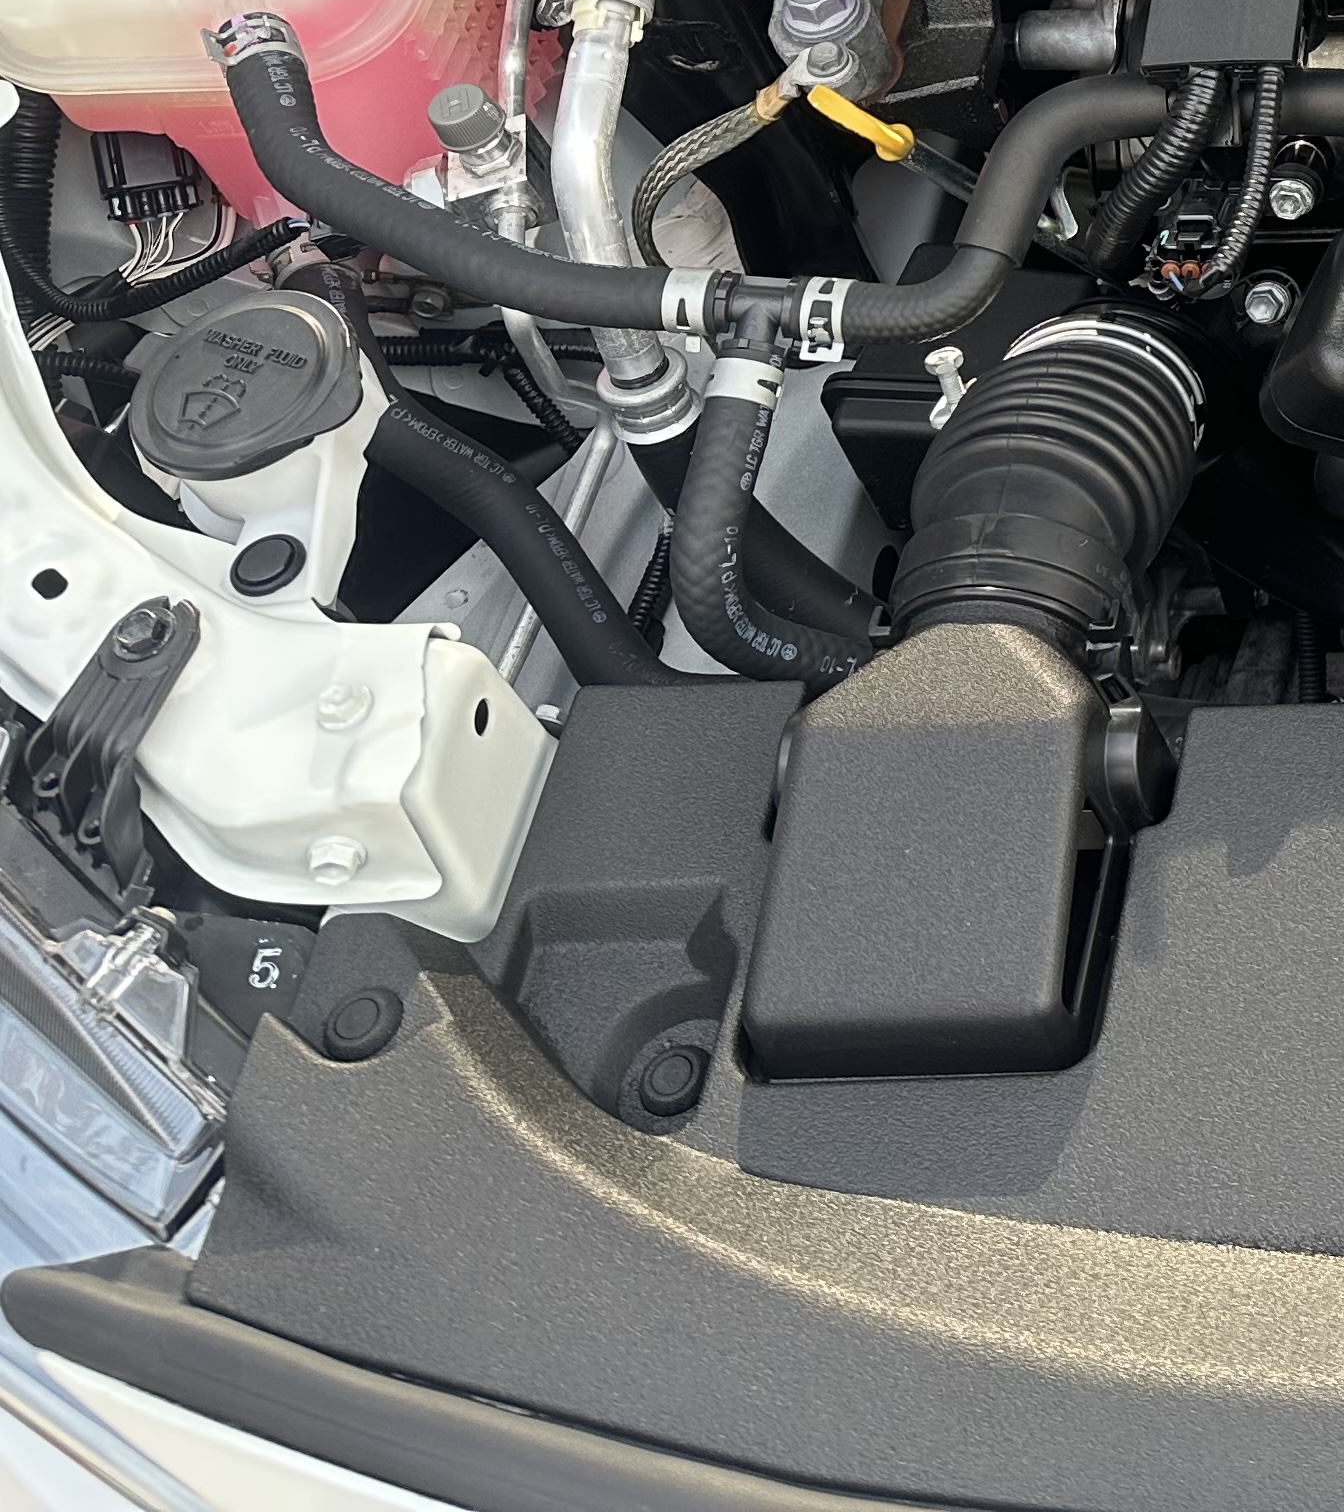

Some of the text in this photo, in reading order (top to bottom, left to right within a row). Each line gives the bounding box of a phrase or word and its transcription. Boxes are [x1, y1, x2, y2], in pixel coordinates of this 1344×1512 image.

[438, 87, 470, 119] H
[202, 329, 308, 369] WASHER FLUID
[223, 353, 265, 375] ONLY
[442, 434, 475, 460] WATER
[472, 450, 492, 469] TGR
[560, 556, 585, 586] WATER
[248, 947, 283, 989] 5
